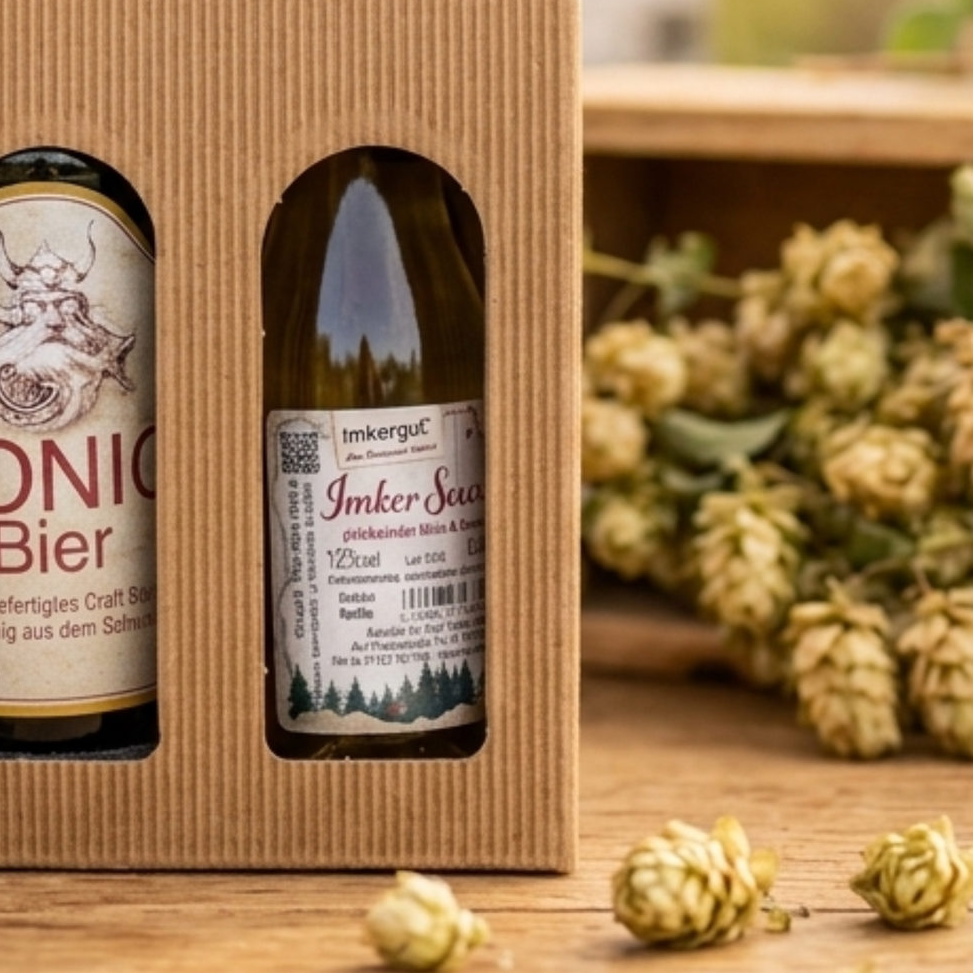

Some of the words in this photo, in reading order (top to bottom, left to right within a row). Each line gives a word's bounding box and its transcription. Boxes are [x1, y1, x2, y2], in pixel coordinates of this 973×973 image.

[320, 473, 420, 521] Imker
[23, 624, 54, 640] aus
[59, 620, 97, 639] dem
